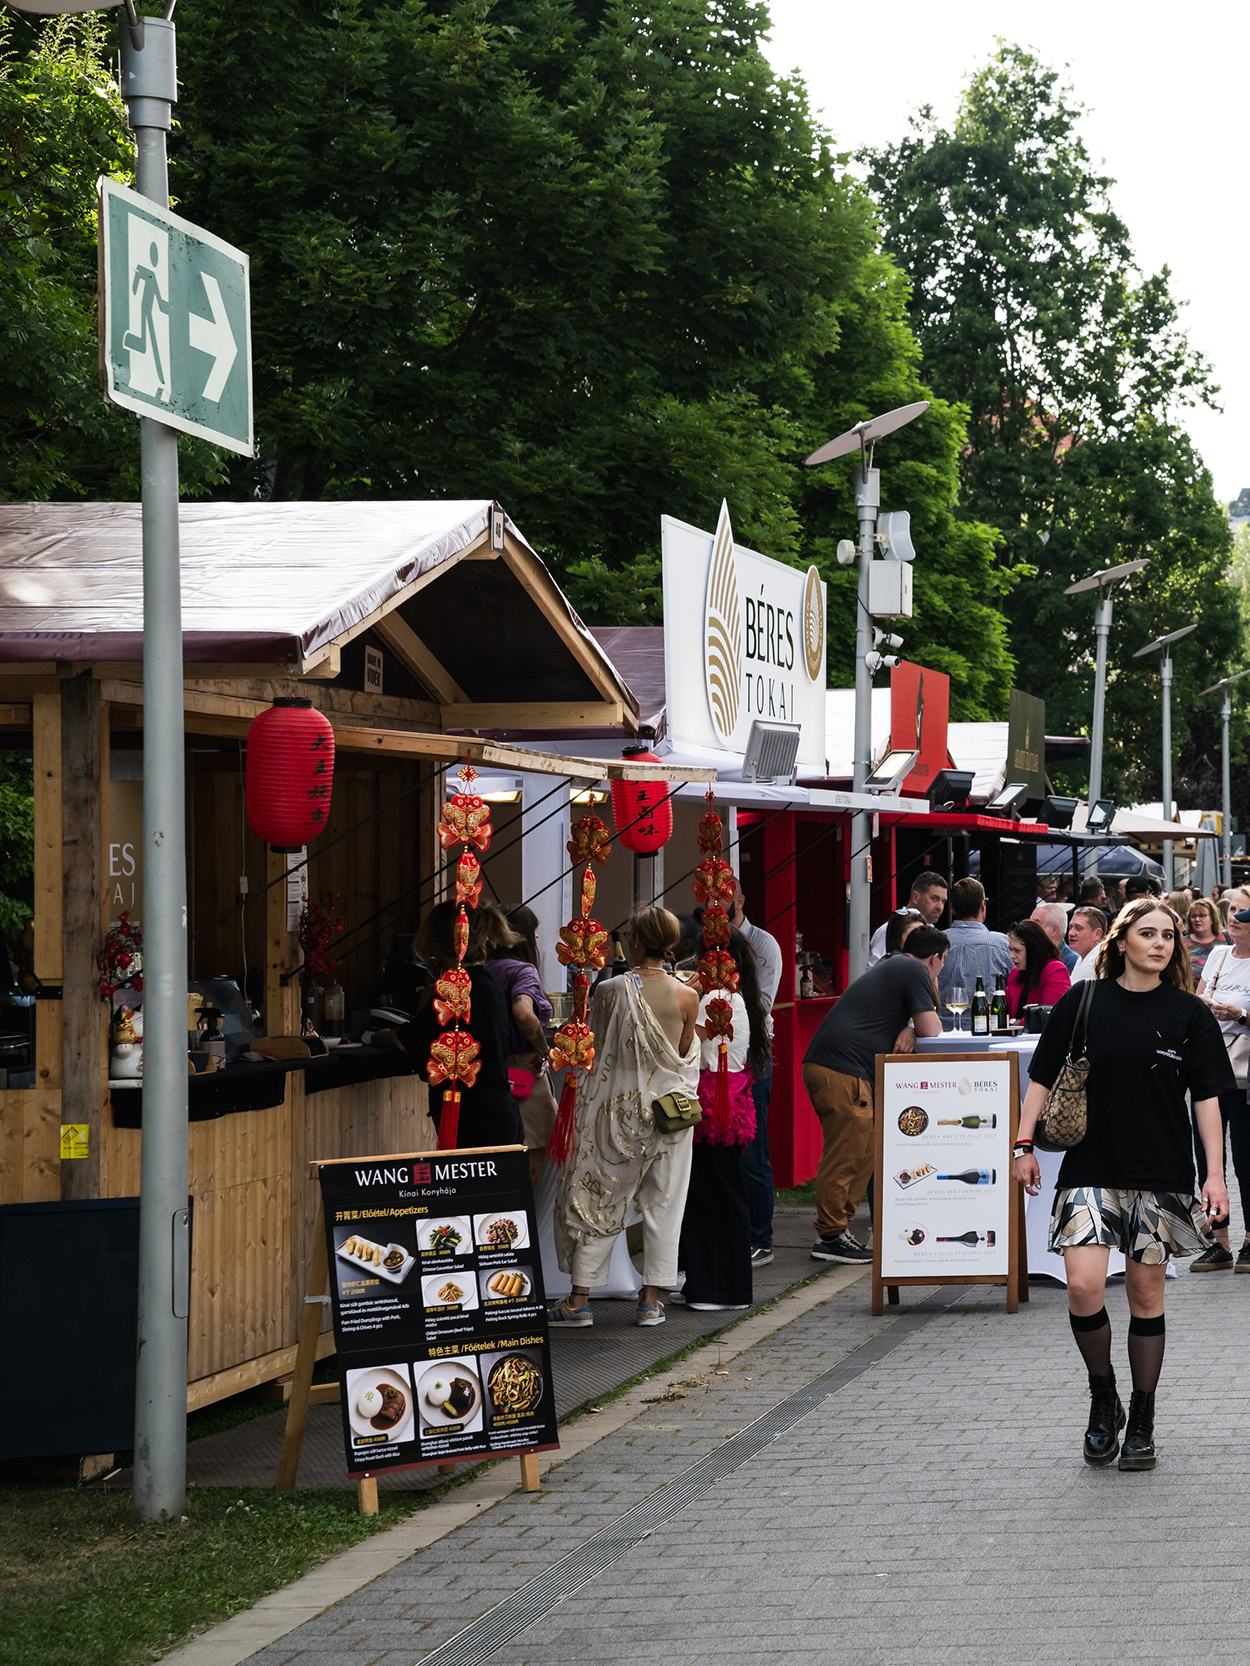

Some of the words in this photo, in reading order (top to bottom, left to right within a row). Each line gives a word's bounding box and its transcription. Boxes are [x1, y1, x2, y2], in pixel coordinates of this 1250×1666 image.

[745, 584, 795, 671] BÉRES
[745, 672, 794, 723] TOKAJ
[895, 1082, 919, 1090] WANG
[929, 1081, 957, 1089] MESTER
[974, 1080, 998, 1088] BÉRES
[355, 1167, 409, 1186] WANG
[435, 1161, 498, 1180] MESTER
[399, 1188, 419, 1198] Kínai
[421, 1186, 457, 1197] Konyhája
[428, 1345, 459, 1357] 特色主菜
[497, 1339, 518, 1348] /Main
[520, 1336, 544, 1345] Dishes
